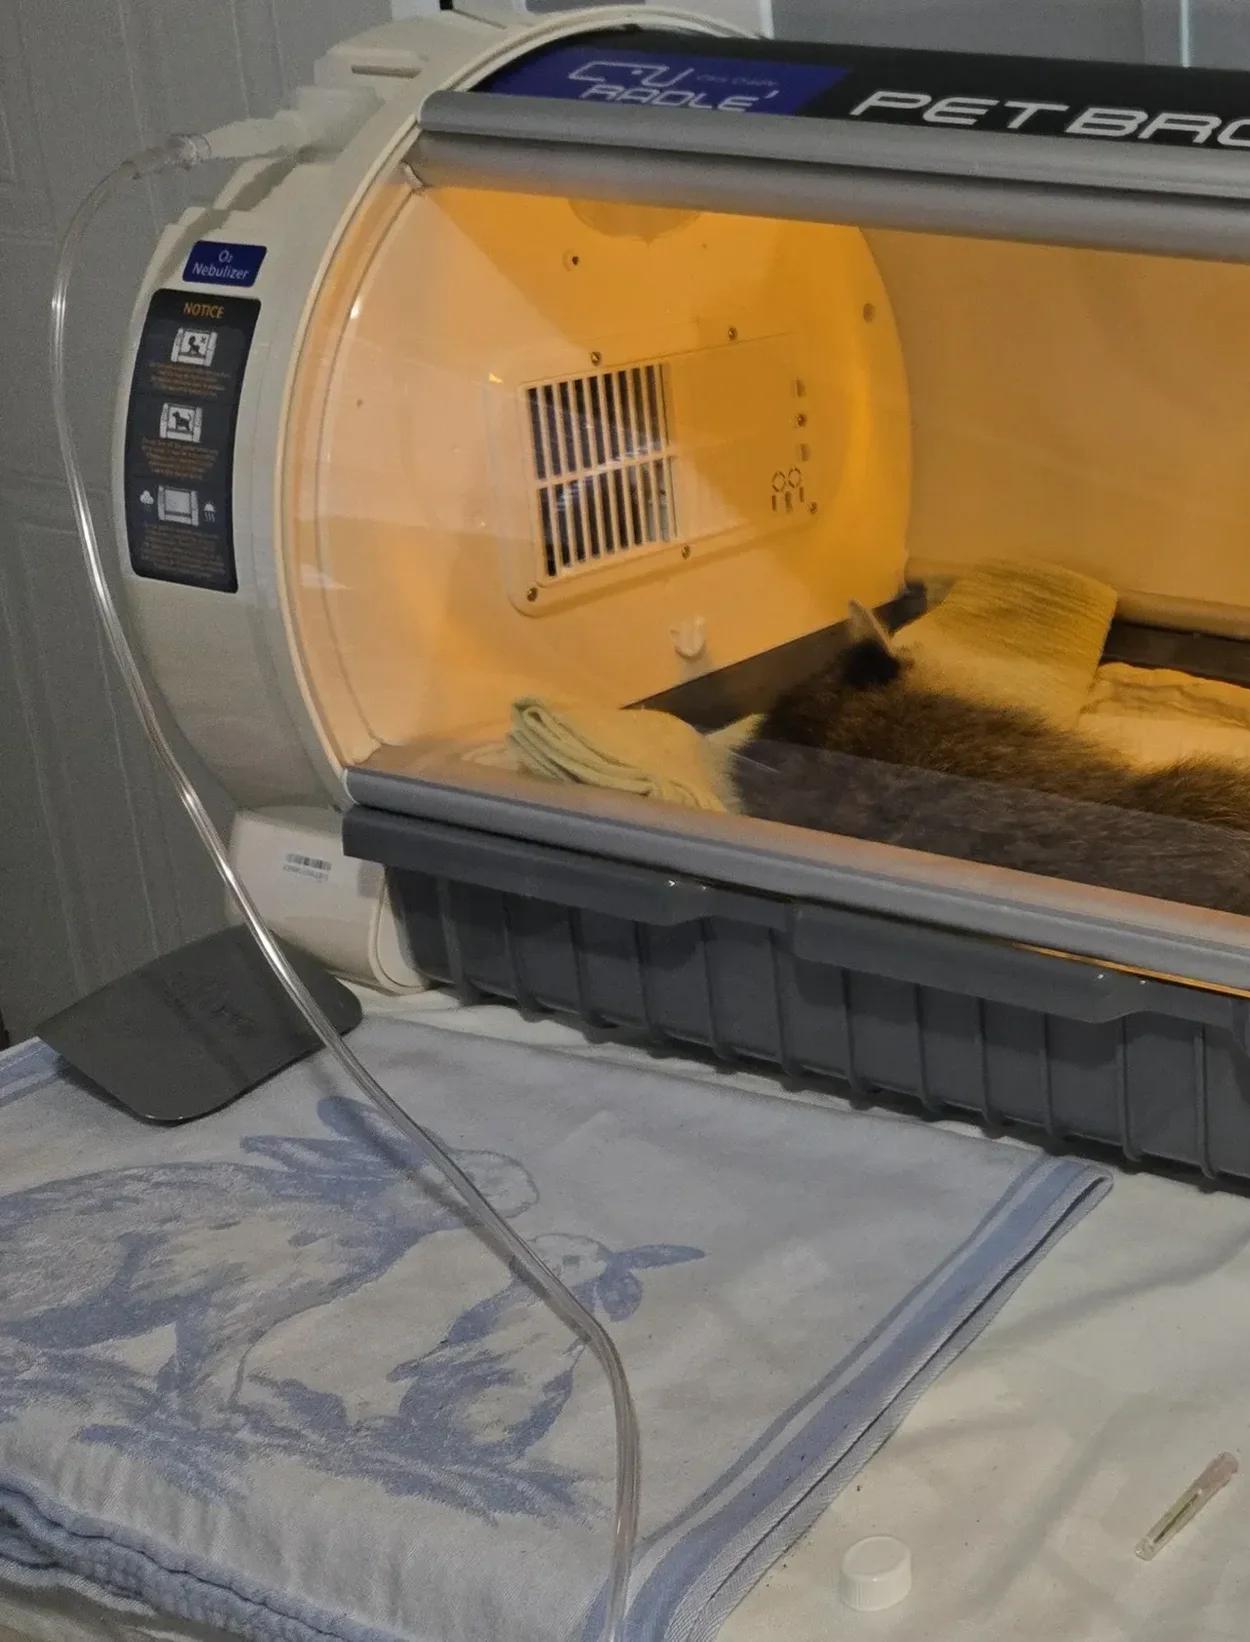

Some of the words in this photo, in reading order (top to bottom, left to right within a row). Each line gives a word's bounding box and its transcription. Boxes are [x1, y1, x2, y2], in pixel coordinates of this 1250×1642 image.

[849, 90, 1069, 129] PET
[191, 262, 250, 280] Nebulizer
[183, 302, 225, 319] NOTICE
